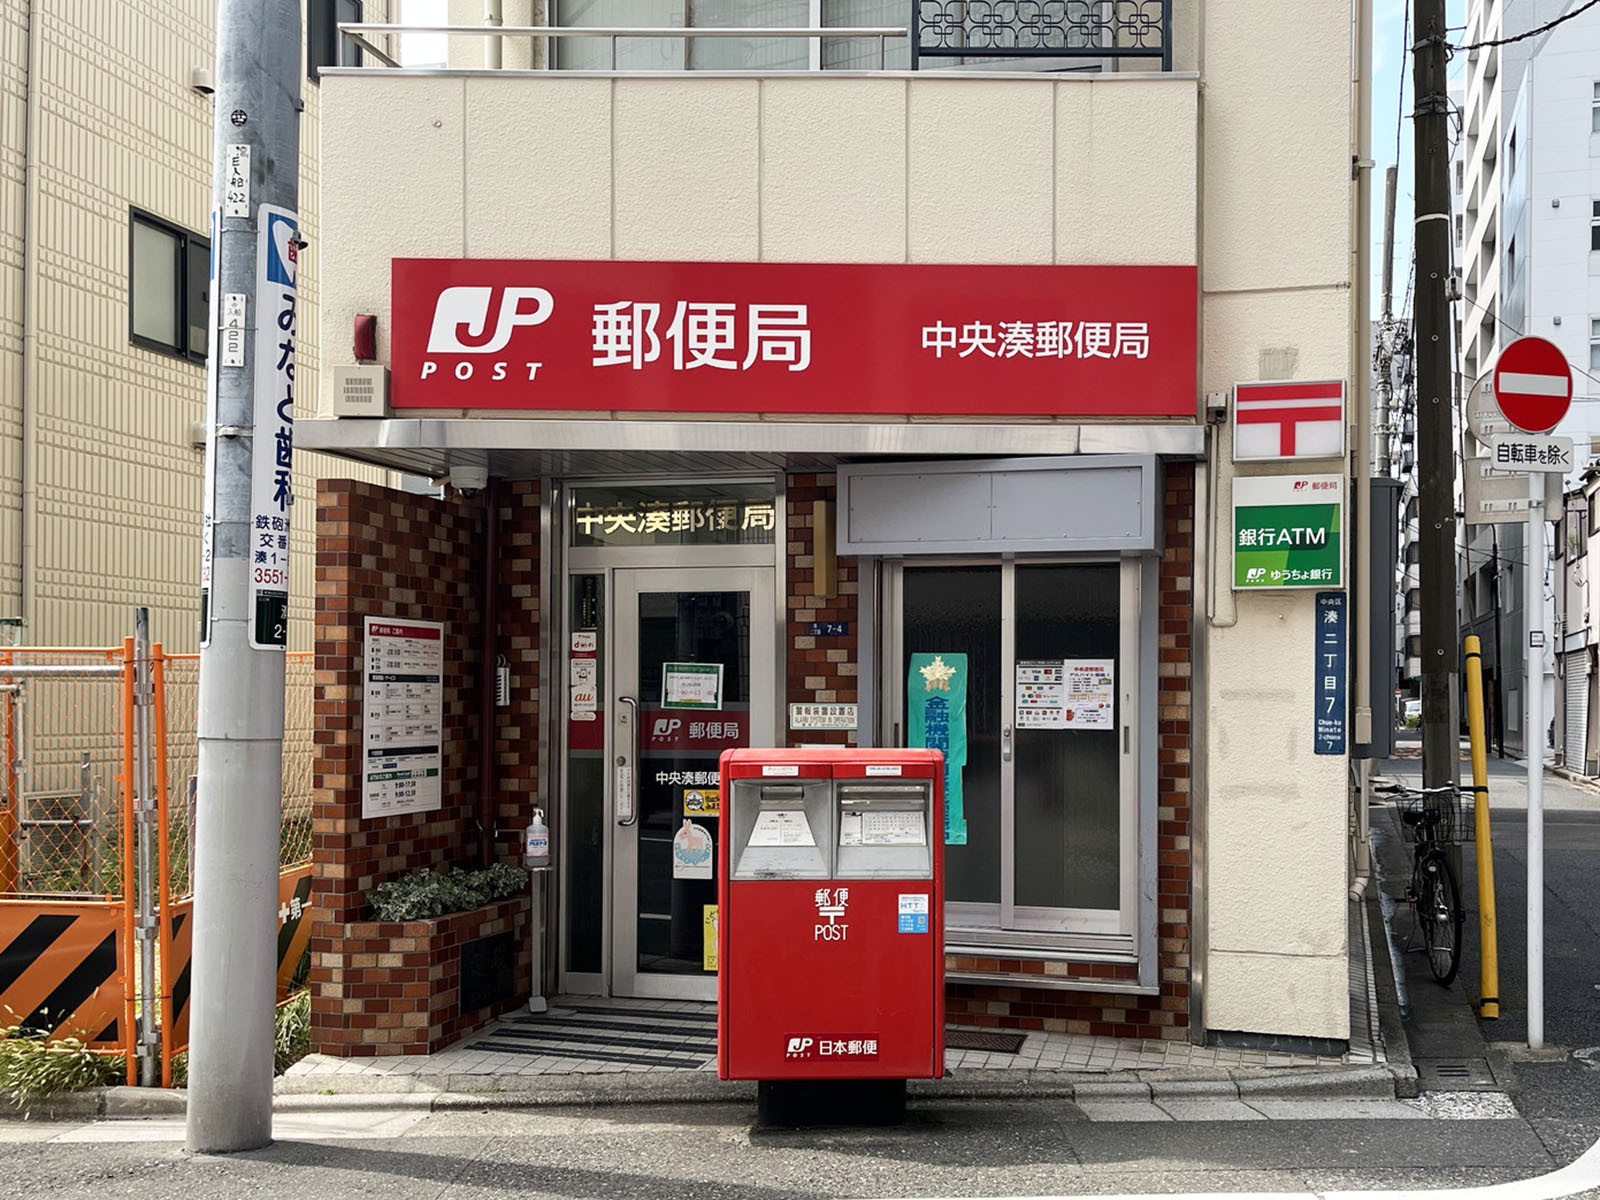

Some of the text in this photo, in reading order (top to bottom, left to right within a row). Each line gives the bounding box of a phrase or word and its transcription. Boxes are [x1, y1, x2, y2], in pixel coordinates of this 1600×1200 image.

[591, 301, 811, 372] 郵便局
[921, 320, 1150, 359] 中央湊郵便局
[421, 362, 542, 381] POST
[1497, 442, 1569, 465] 自転車を除く
[1312, 481, 1338, 491] 郵便局
[576, 499, 775, 534] 中央湊郵便局
[1239, 528, 1325, 546] 銀行ATM
[1271, 568, 1332, 581] ゆうちょ銀行
[574, 693, 594, 701] au
[689, 721, 739, 739] 郵便局
[1327, 742, 1333, 750] 7
[815, 888, 848, 907] 郵便
[815, 925, 848, 940] POST
[819, 1040, 877, 1055] 日本郵便
